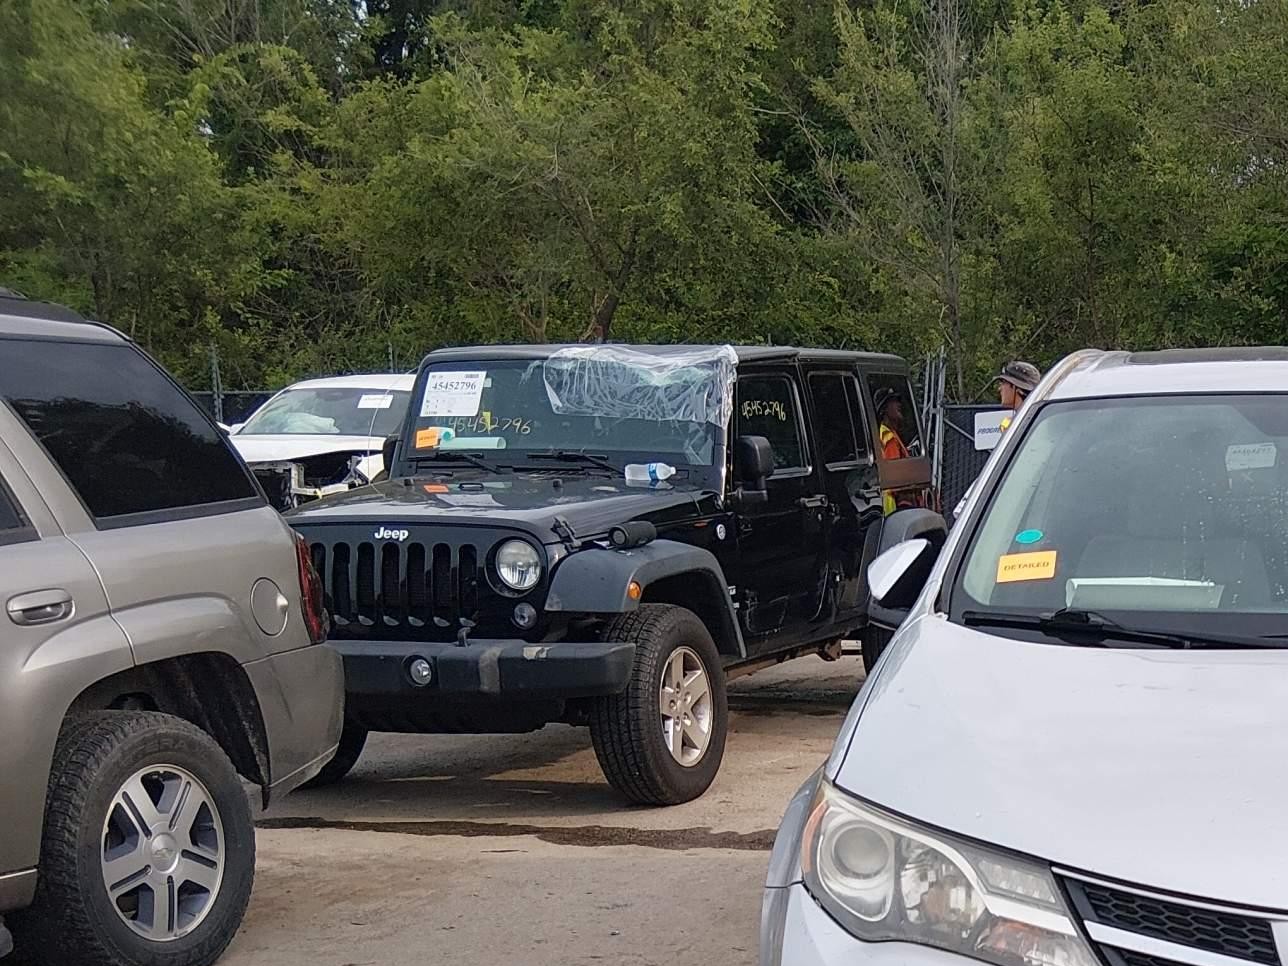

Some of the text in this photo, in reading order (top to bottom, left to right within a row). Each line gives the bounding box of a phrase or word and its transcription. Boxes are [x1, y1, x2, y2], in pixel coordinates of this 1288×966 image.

[432, 381, 477, 391] 45452796
[741, 400, 787, 421] 45452796
[449, 417, 532, 434] 45452796
[374, 526, 409, 541] Jeep
[1003, 561, 1050, 571] DETAILED
